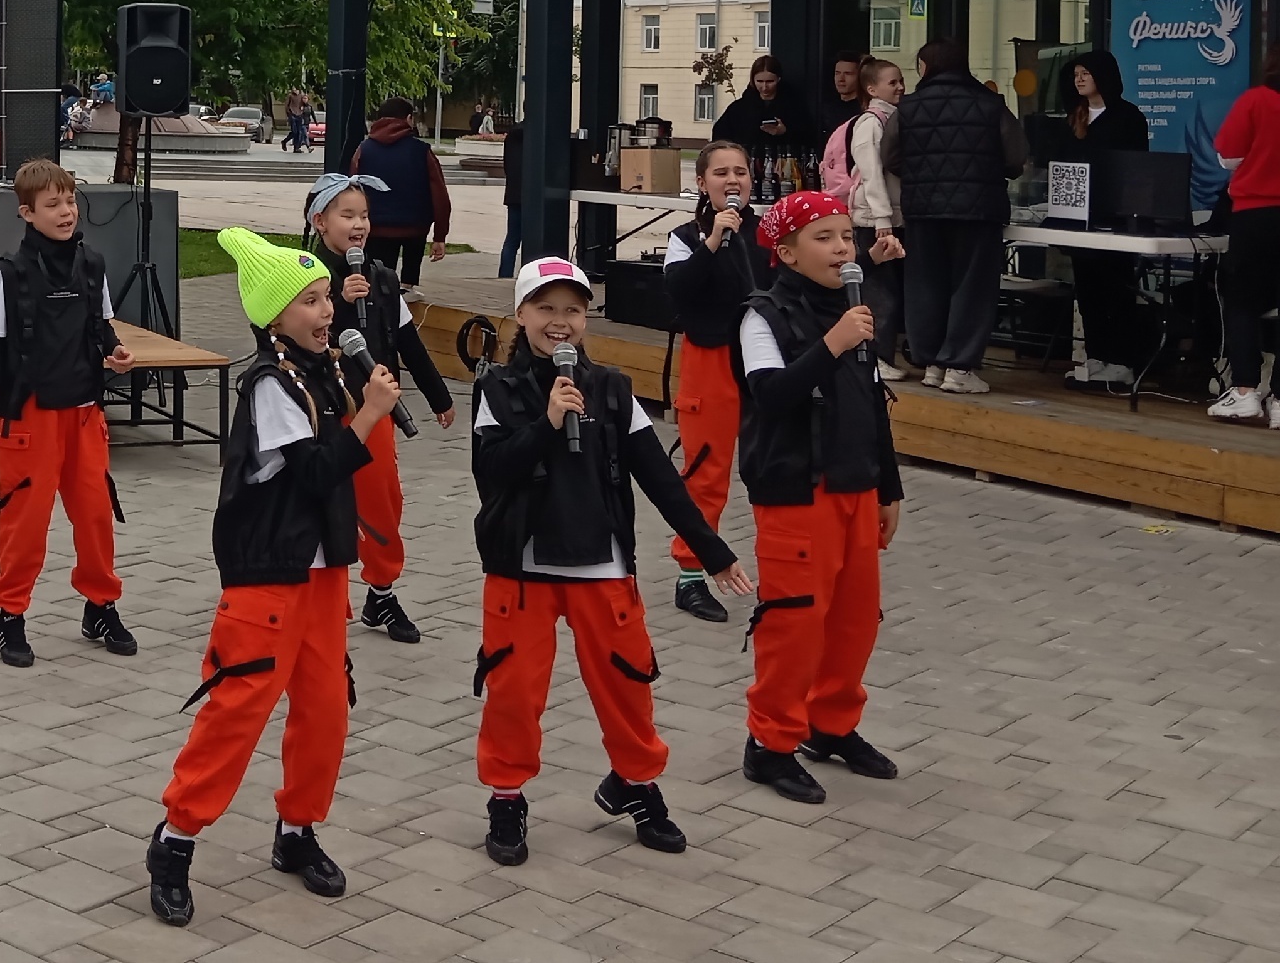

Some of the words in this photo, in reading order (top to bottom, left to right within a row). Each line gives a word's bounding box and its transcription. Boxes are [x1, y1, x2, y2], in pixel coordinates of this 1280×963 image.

[1128, 11, 1212, 49] Феникс
[1137, 64, 1162, 72] РИТМИКА
[1196, 77, 1216, 85] СПОРТА
[1138, 89, 1176, 99] ТАНЦЕВАЛЬНЫЙ
[1177, 91, 1194, 99] СПОРТ
